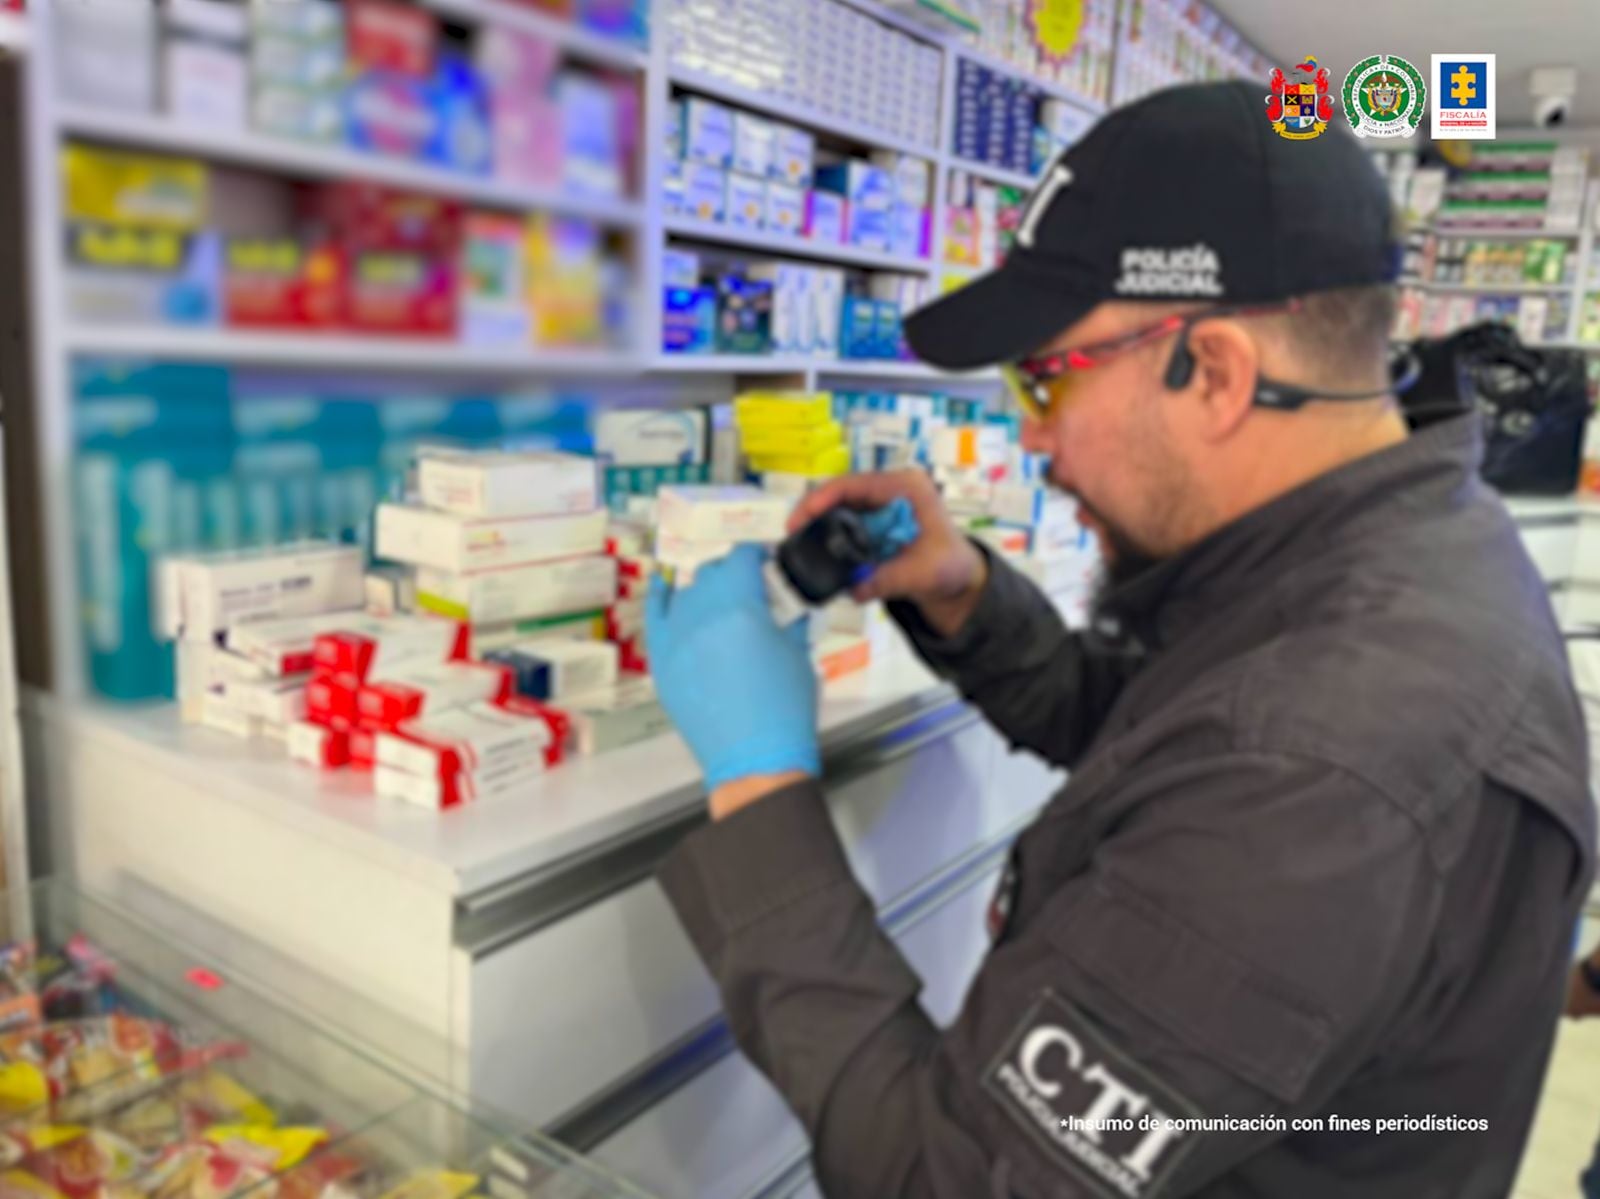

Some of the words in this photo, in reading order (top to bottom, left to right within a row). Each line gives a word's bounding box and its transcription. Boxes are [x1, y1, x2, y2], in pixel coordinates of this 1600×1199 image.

[1120, 242, 1220, 271] POLICÍA
[1115, 271, 1224, 295] JUDICIAL
[1020, 1024, 1183, 1180] CTI
